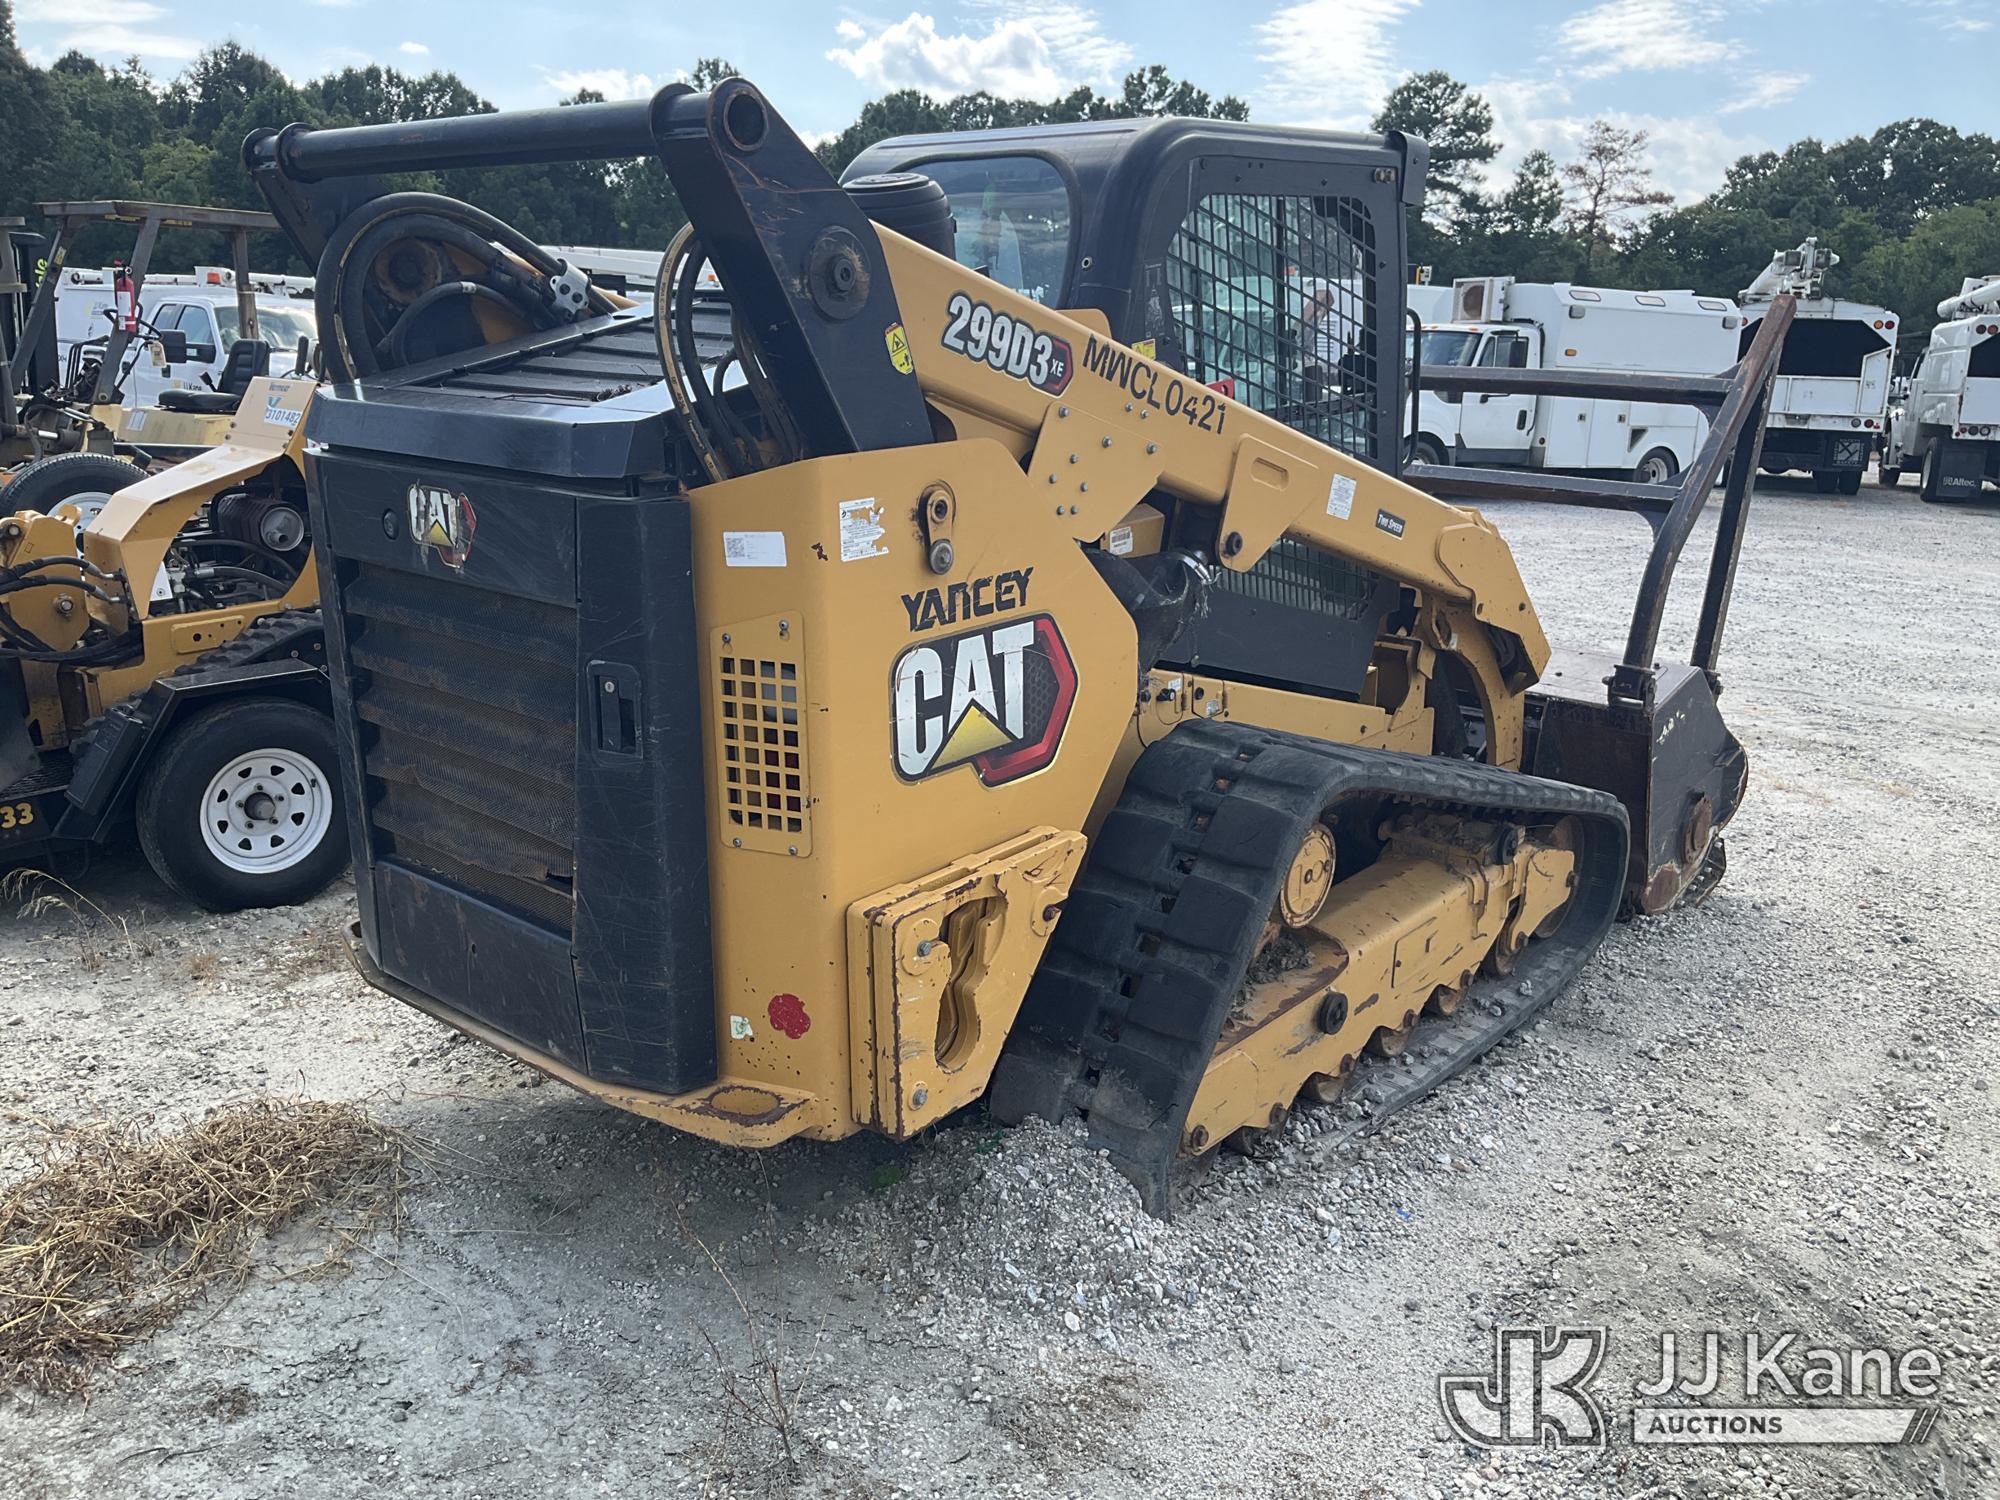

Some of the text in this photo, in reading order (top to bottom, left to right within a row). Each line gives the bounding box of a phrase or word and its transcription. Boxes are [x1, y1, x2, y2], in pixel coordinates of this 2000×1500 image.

[943, 295, 1064, 386] 299D3 XE
[265, 408, 301, 424] 3101482
[1952, 477, 1975, 488] Altec
[409, 488, 459, 548] CAT
[900, 566, 1035, 632] YANCEY
[895, 620, 1035, 776] CAT
